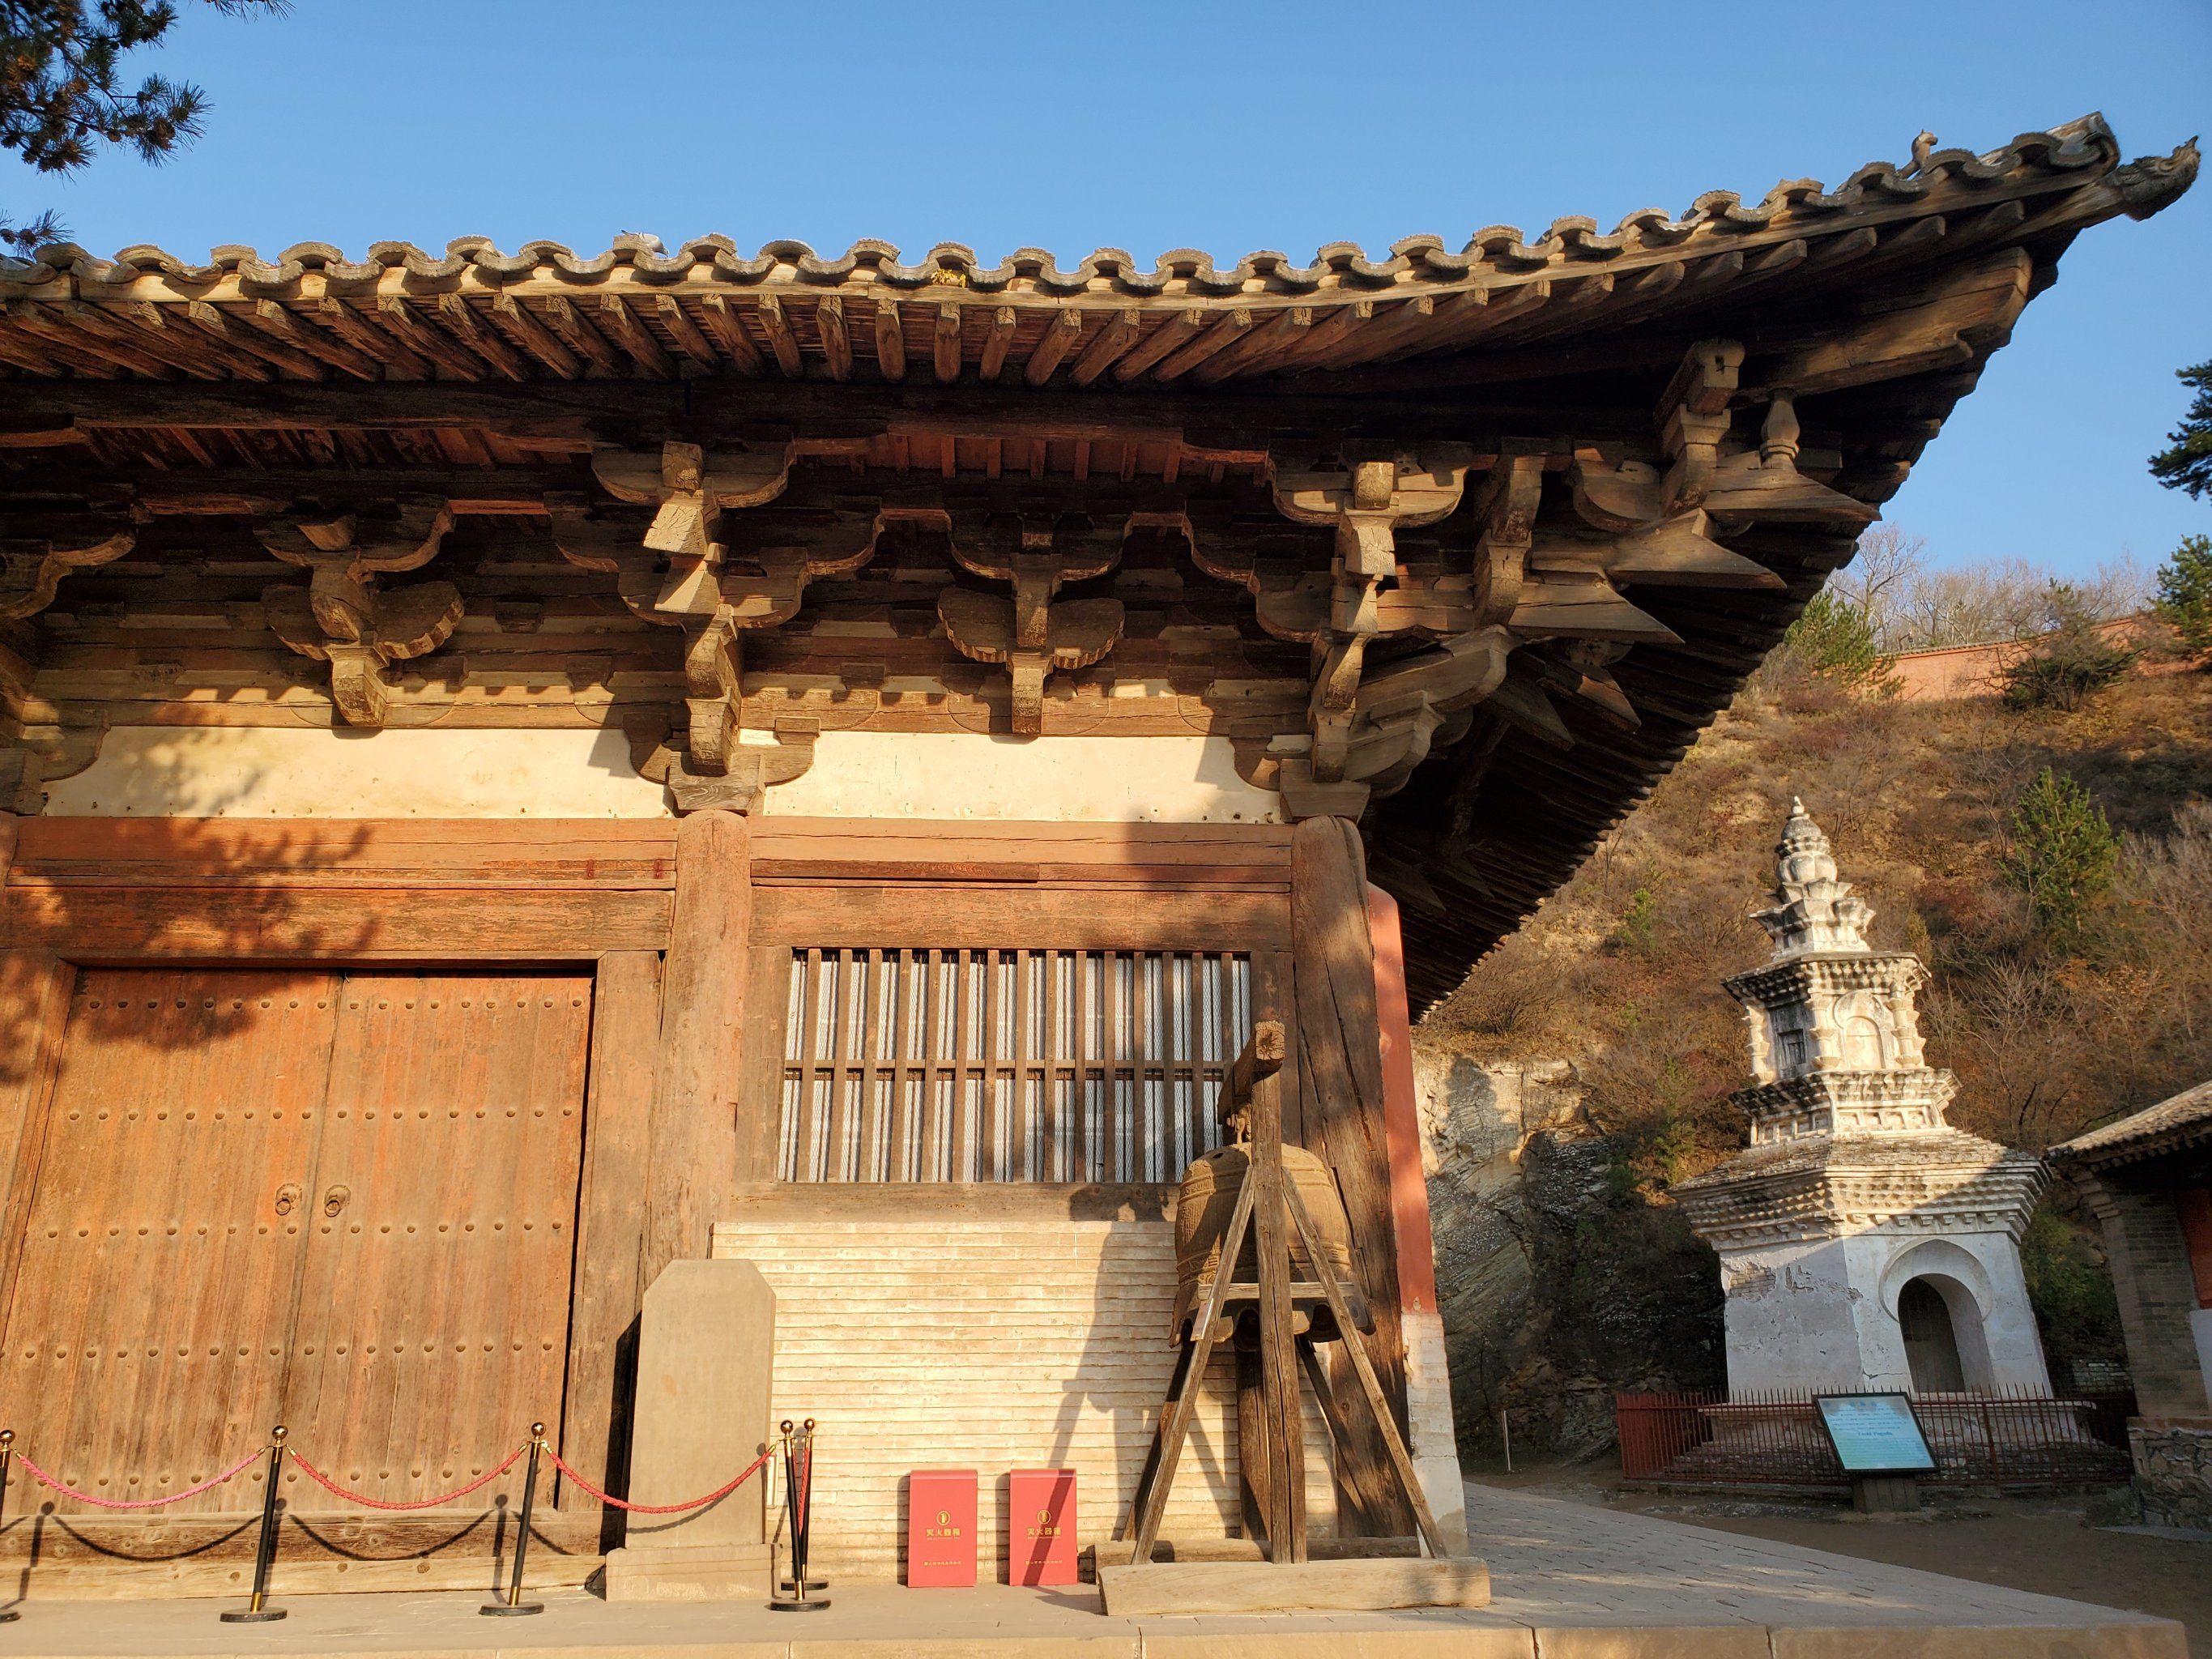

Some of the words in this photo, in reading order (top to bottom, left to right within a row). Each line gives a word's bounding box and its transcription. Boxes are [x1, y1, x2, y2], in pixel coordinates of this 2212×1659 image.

[926, 1528, 961, 1537] 灭火器箱
[1027, 1527, 1061, 1536] 灭火器箱
